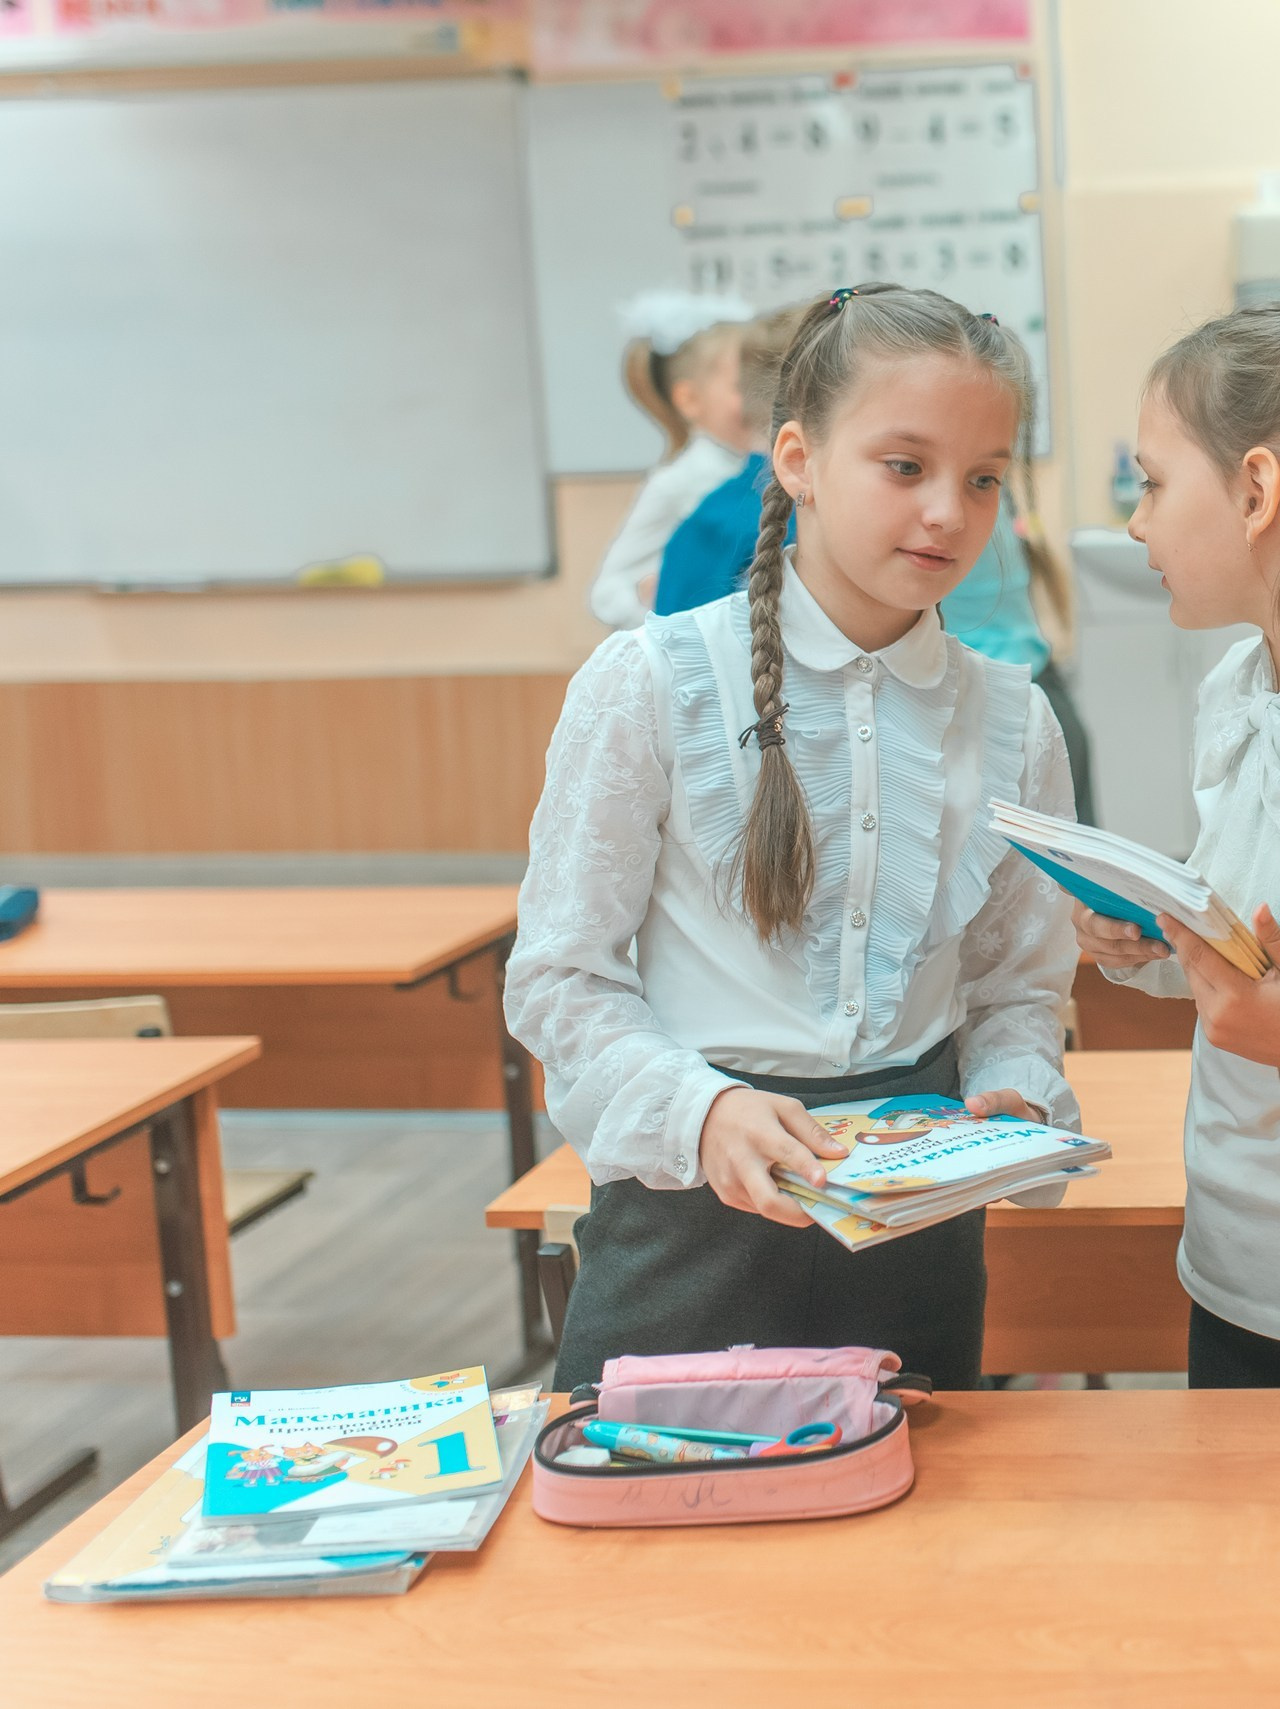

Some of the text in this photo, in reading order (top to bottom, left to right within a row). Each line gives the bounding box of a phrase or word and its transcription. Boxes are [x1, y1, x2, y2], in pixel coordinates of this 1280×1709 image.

[847, 1127, 1048, 1178] Математика
[865, 1137, 933, 1163] работы
[871, 1127, 1000, 1166] Проверочные
[234, 1396, 463, 1427] Математика
[269, 1414, 422, 1434] Проверочные
[343, 1418, 422, 1435] работы
[417, 1431, 486, 1479] 1
